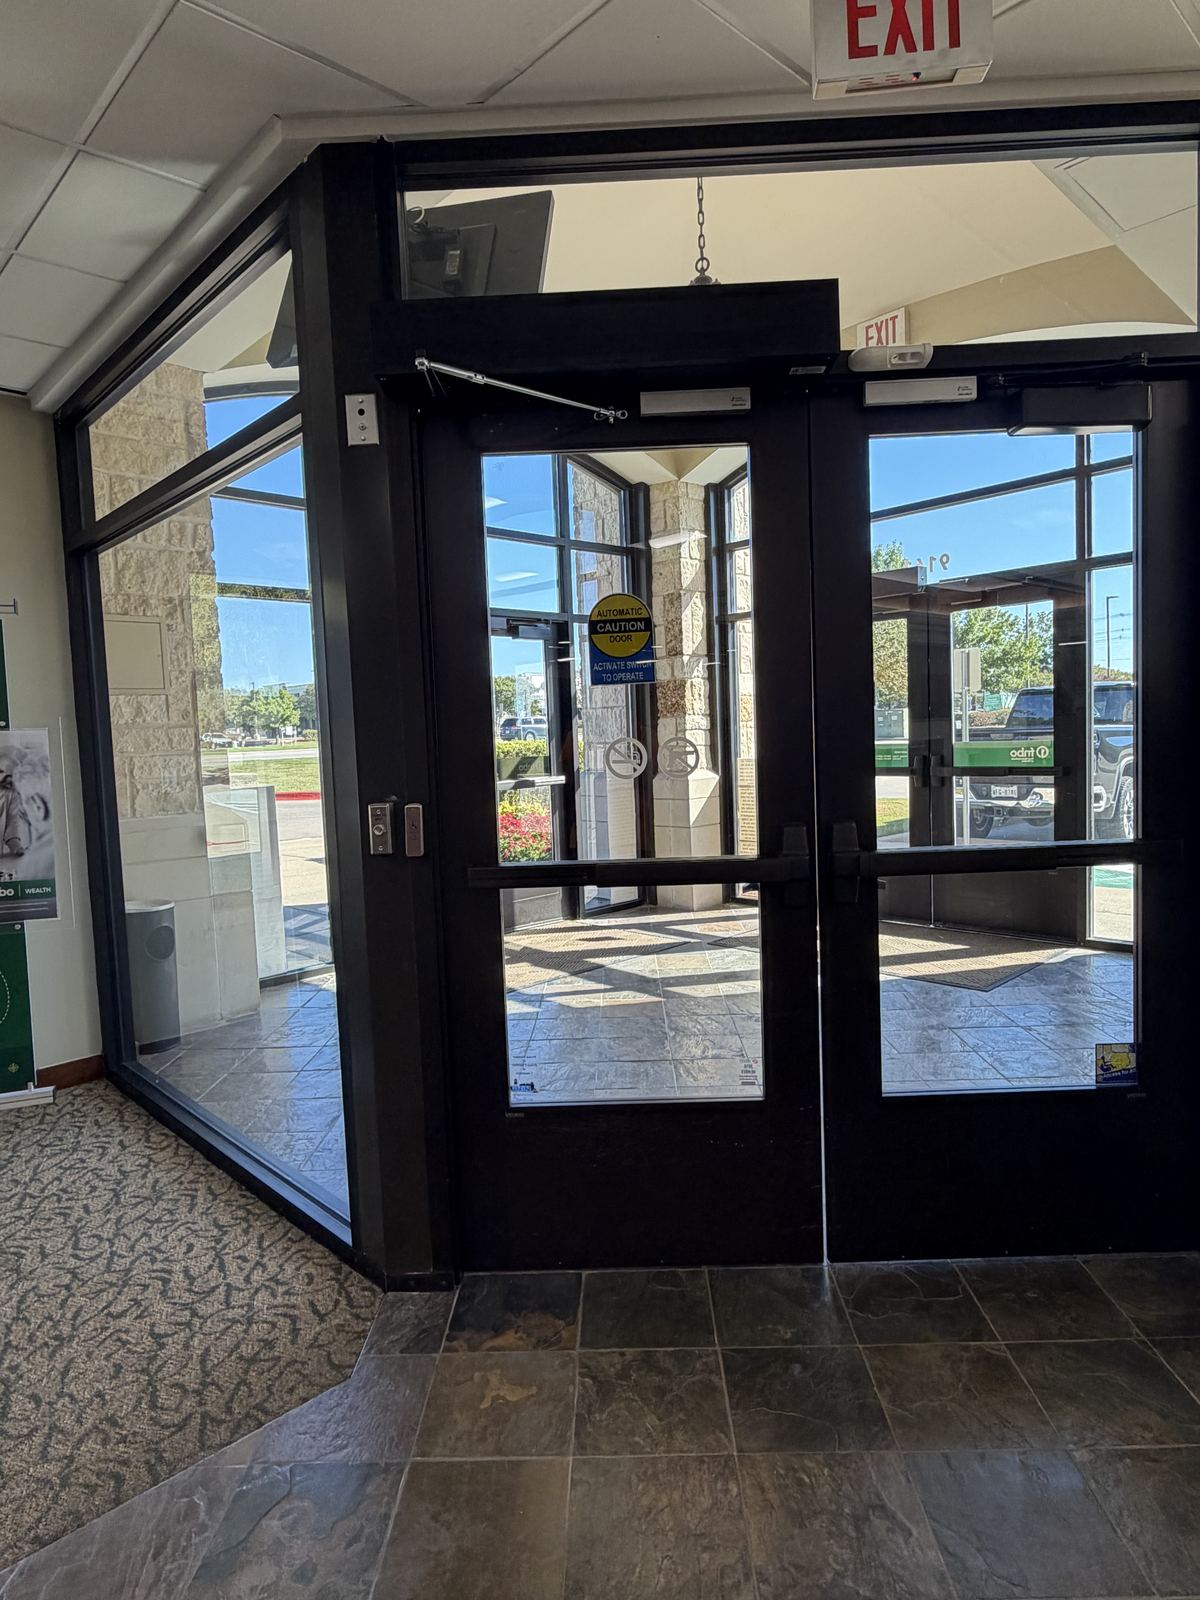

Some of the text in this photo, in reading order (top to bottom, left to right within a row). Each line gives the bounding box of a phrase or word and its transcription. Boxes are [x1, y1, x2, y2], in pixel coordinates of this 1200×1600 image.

[865, 315, 898, 347] EXIT
[597, 608, 642, 617] AUTOMATIC
[597, 621, 645, 632] CAUTION
[609, 635, 632, 643] DOOR
[593, 661, 626, 671] ACTIVATE
[602, 671, 644, 682] TO OPERATE
